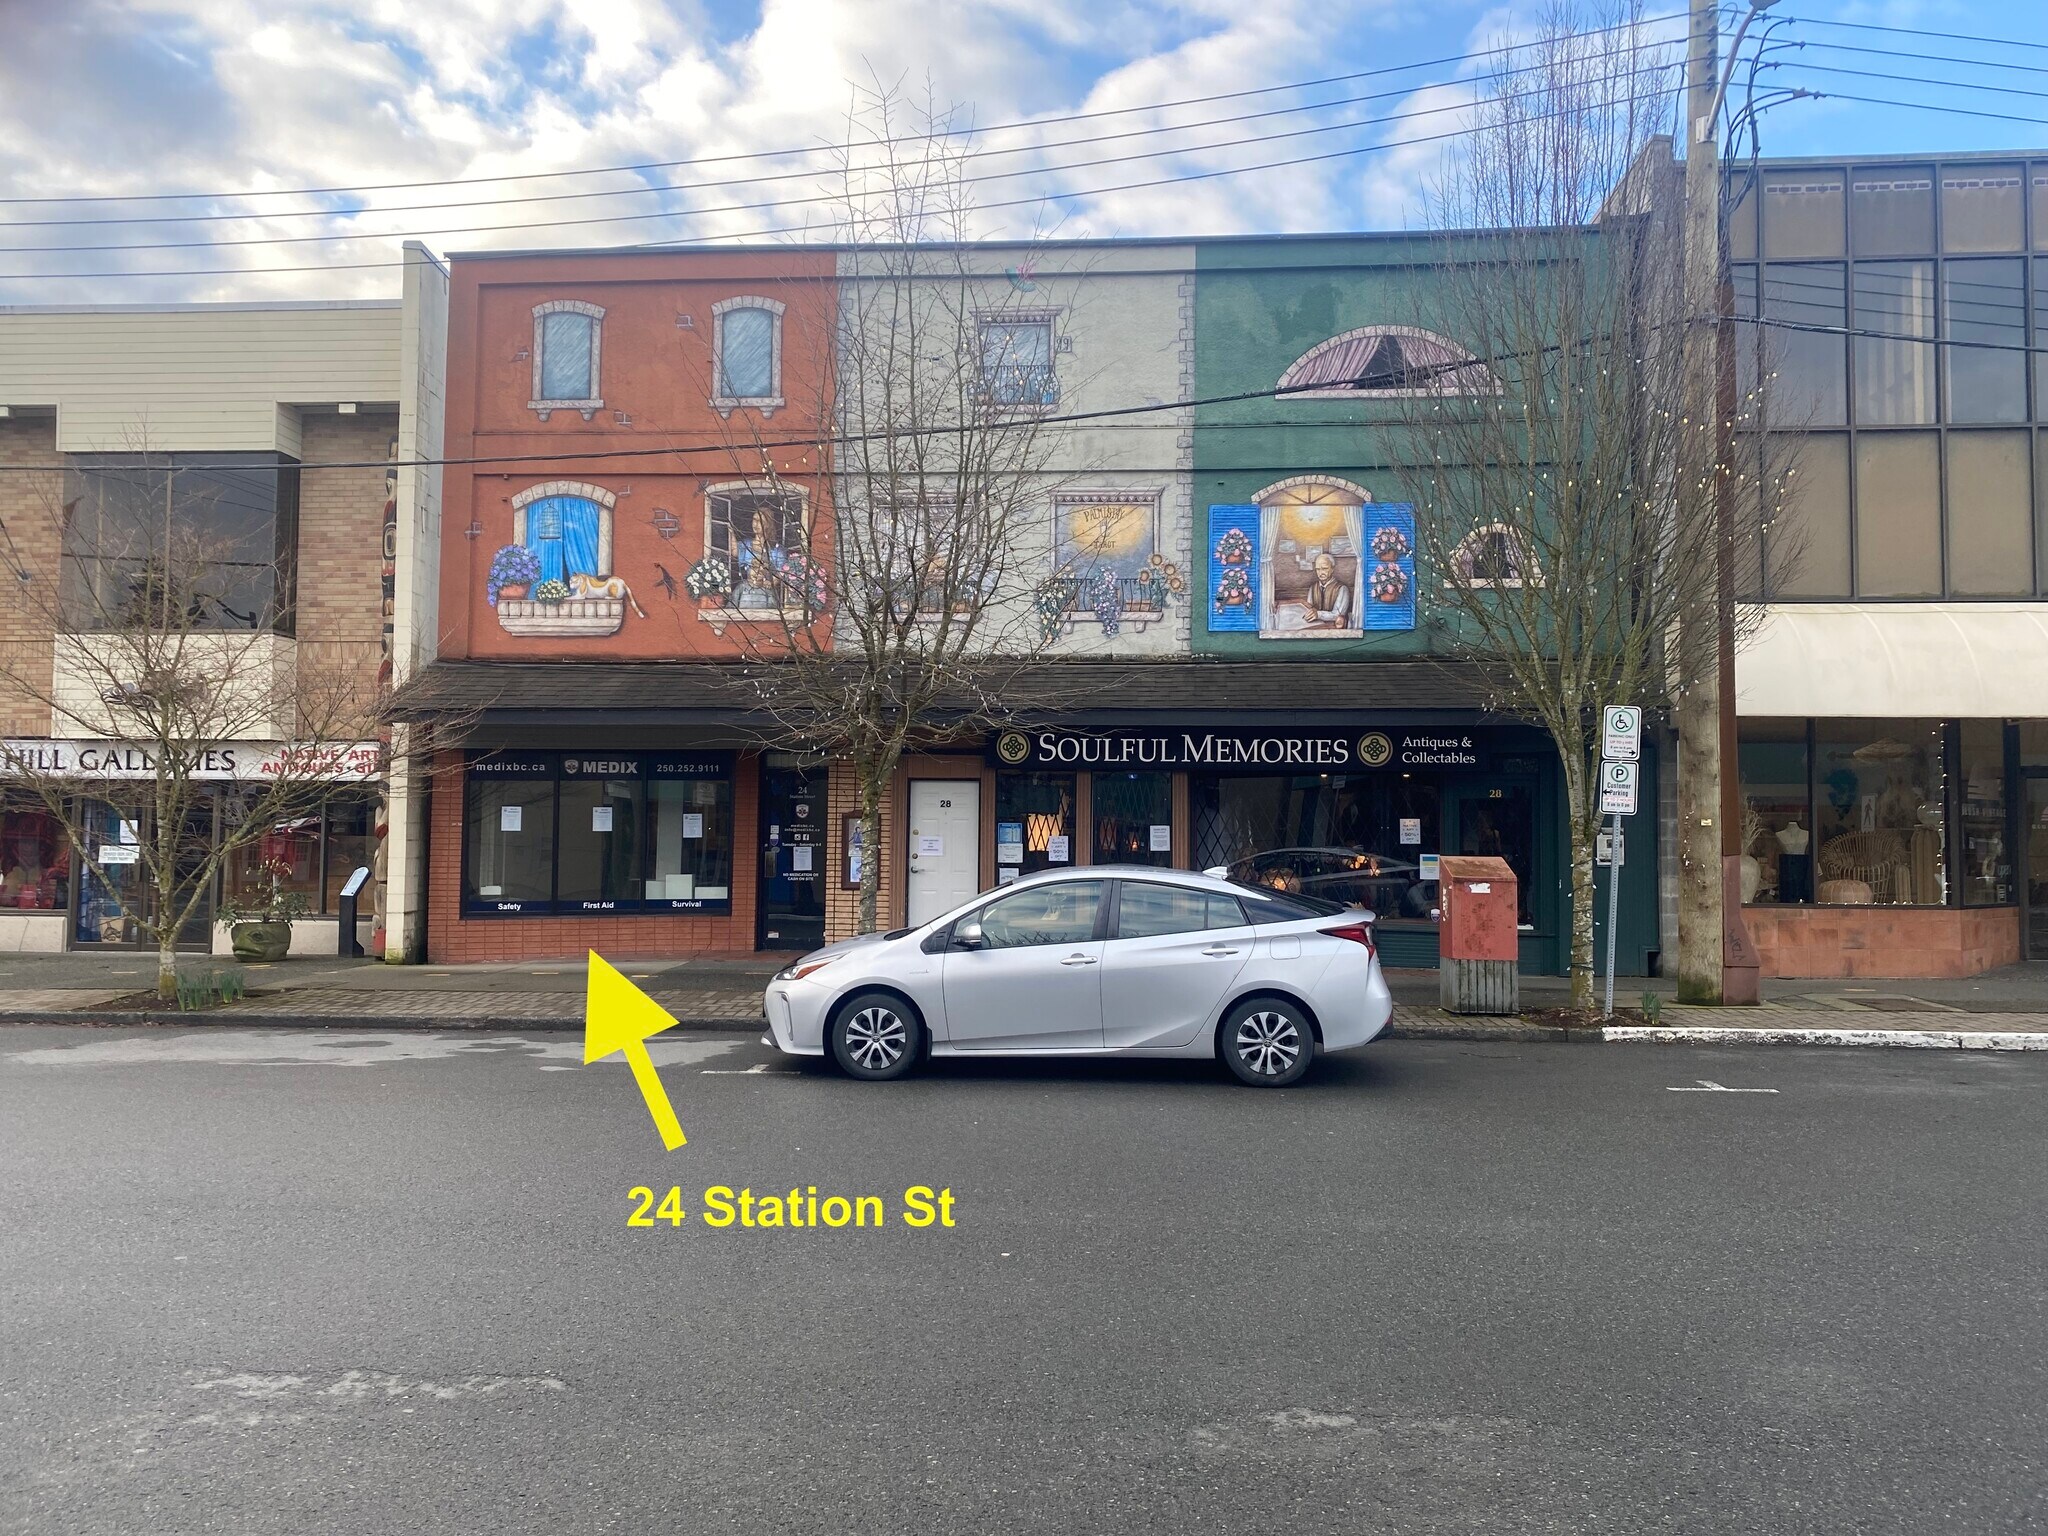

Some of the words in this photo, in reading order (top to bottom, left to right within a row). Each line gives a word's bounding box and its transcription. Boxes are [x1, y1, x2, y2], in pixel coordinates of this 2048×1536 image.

[1084, 507, 1125, 522] PALMISTRY
[1402, 736, 1458, 750] Antiques
[1462, 737, 1472, 747] &
[1039, 734, 1176, 762] SOULFUL
[1181, 735, 1348, 764] MEMORIES
[5, 749, 67, 769] HILL
[1402, 752, 1476, 763] Collectables
[476, 762, 546, 771] medixbc.ca
[582, 761, 638, 774] MEDIX
[656, 764, 719, 773] 250.252.9111
[798, 786, 807, 794] 24
[498, 902, 521, 911] Safety
[672, 900, 702, 908] Survival
